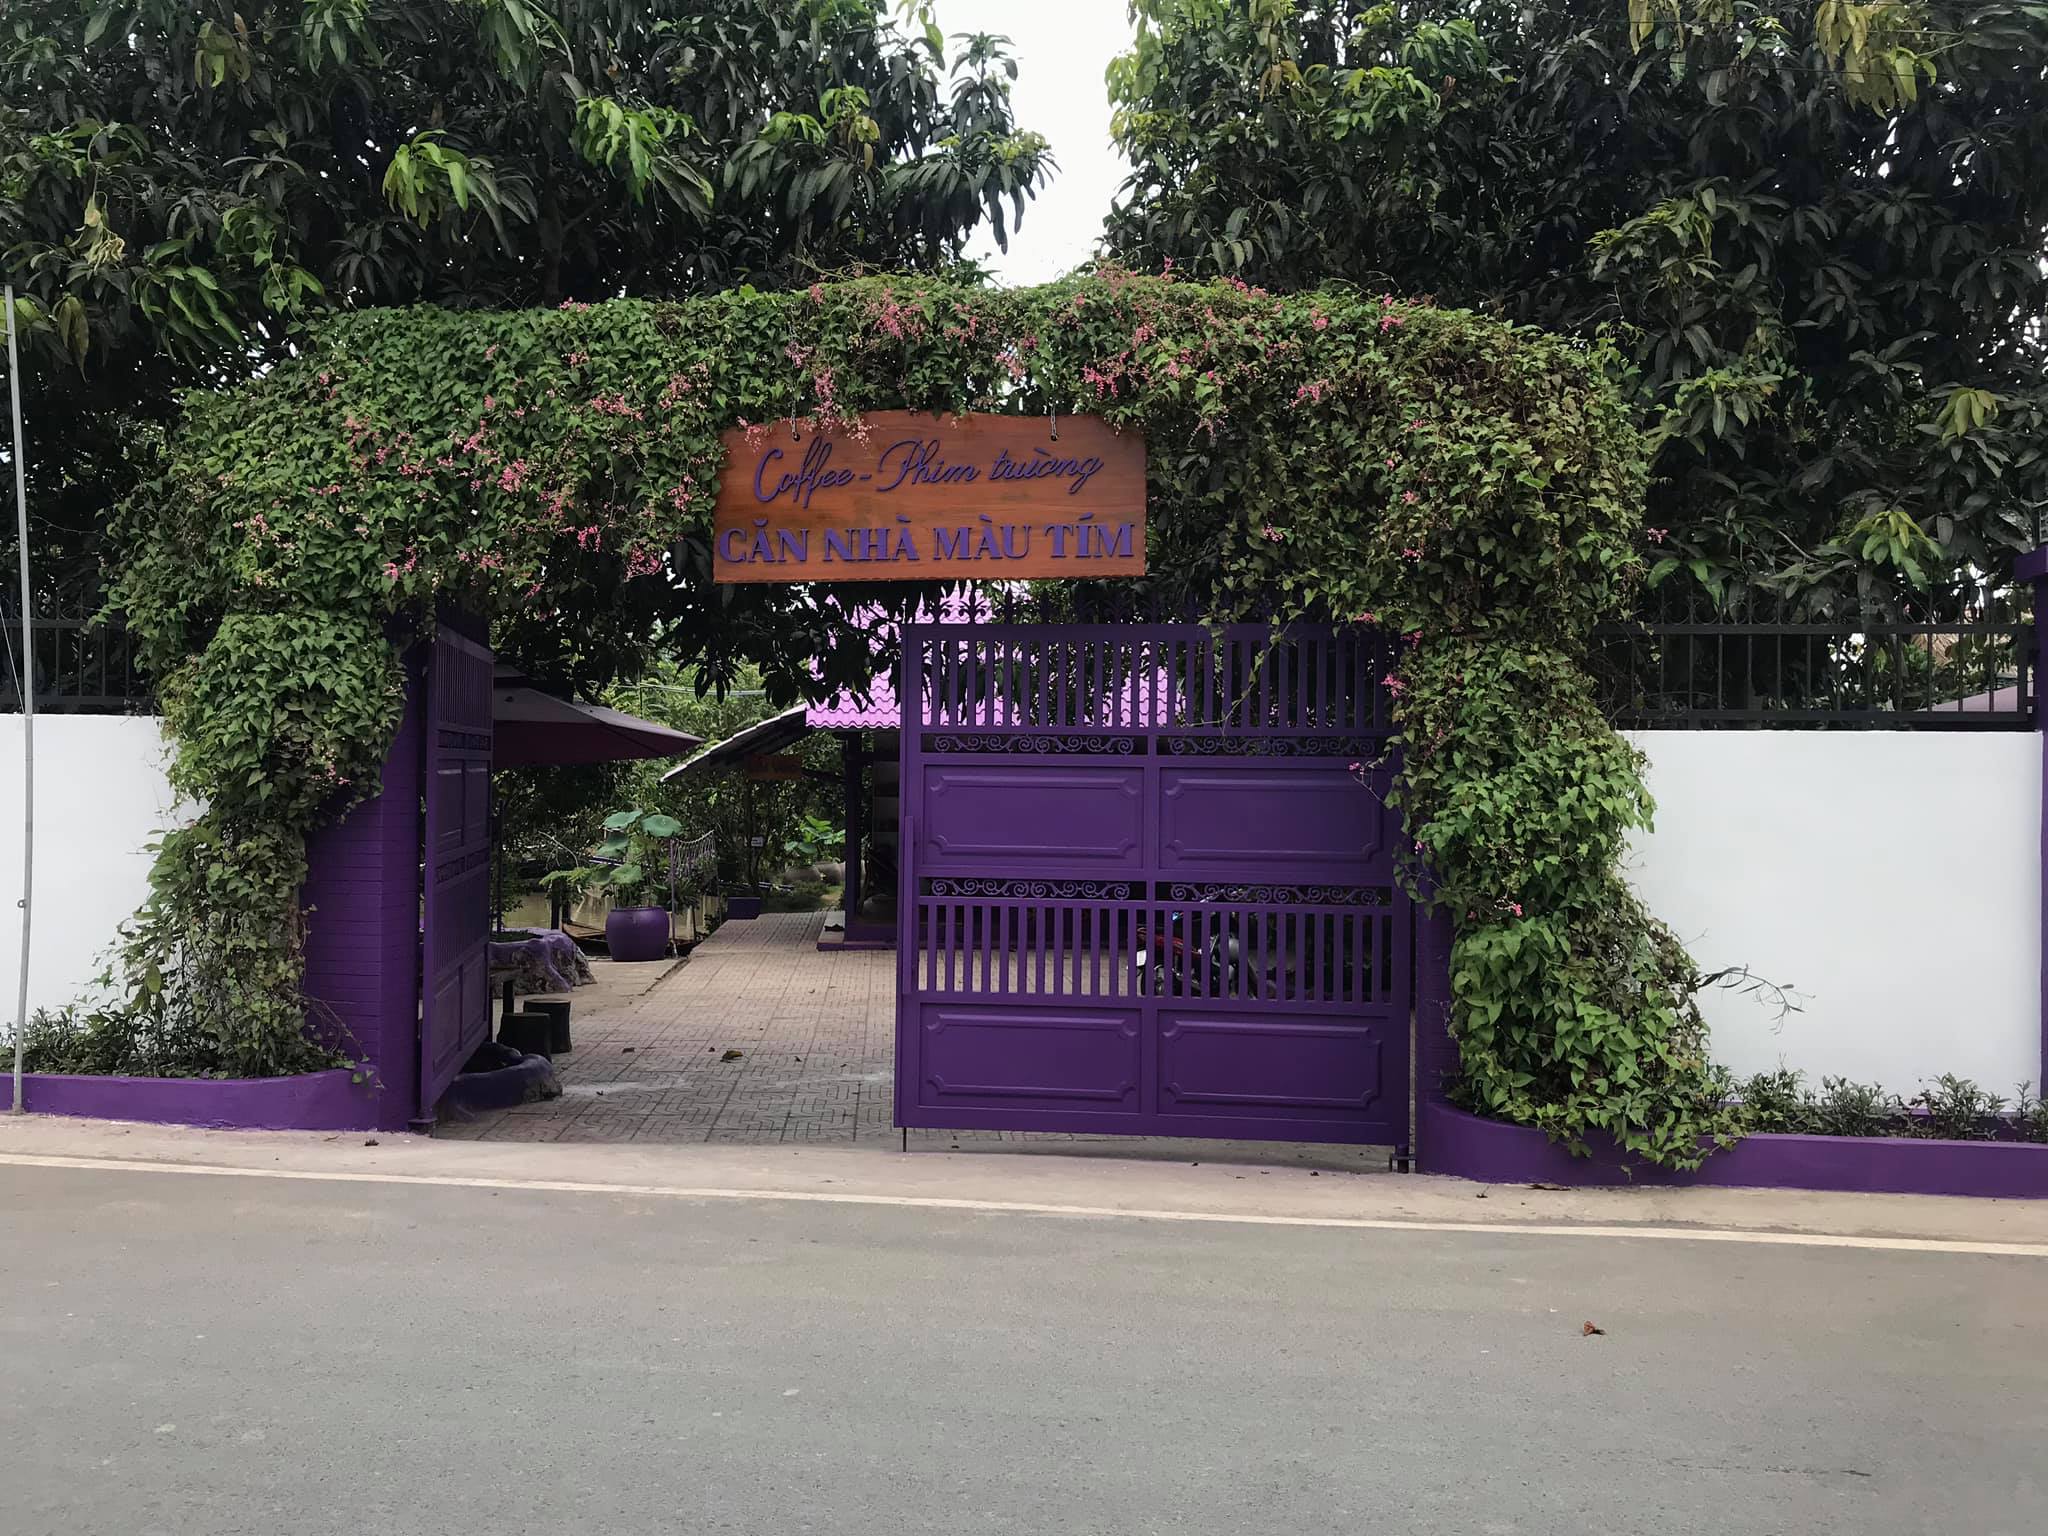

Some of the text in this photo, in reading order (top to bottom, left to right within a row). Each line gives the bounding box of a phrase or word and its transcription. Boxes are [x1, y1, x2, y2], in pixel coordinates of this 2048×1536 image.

[753, 436, 855, 509] Coffee
[876, 438, 981, 492] Phim
[719, 511, 1135, 563] CĂN NHÀ MÀU TÍM
